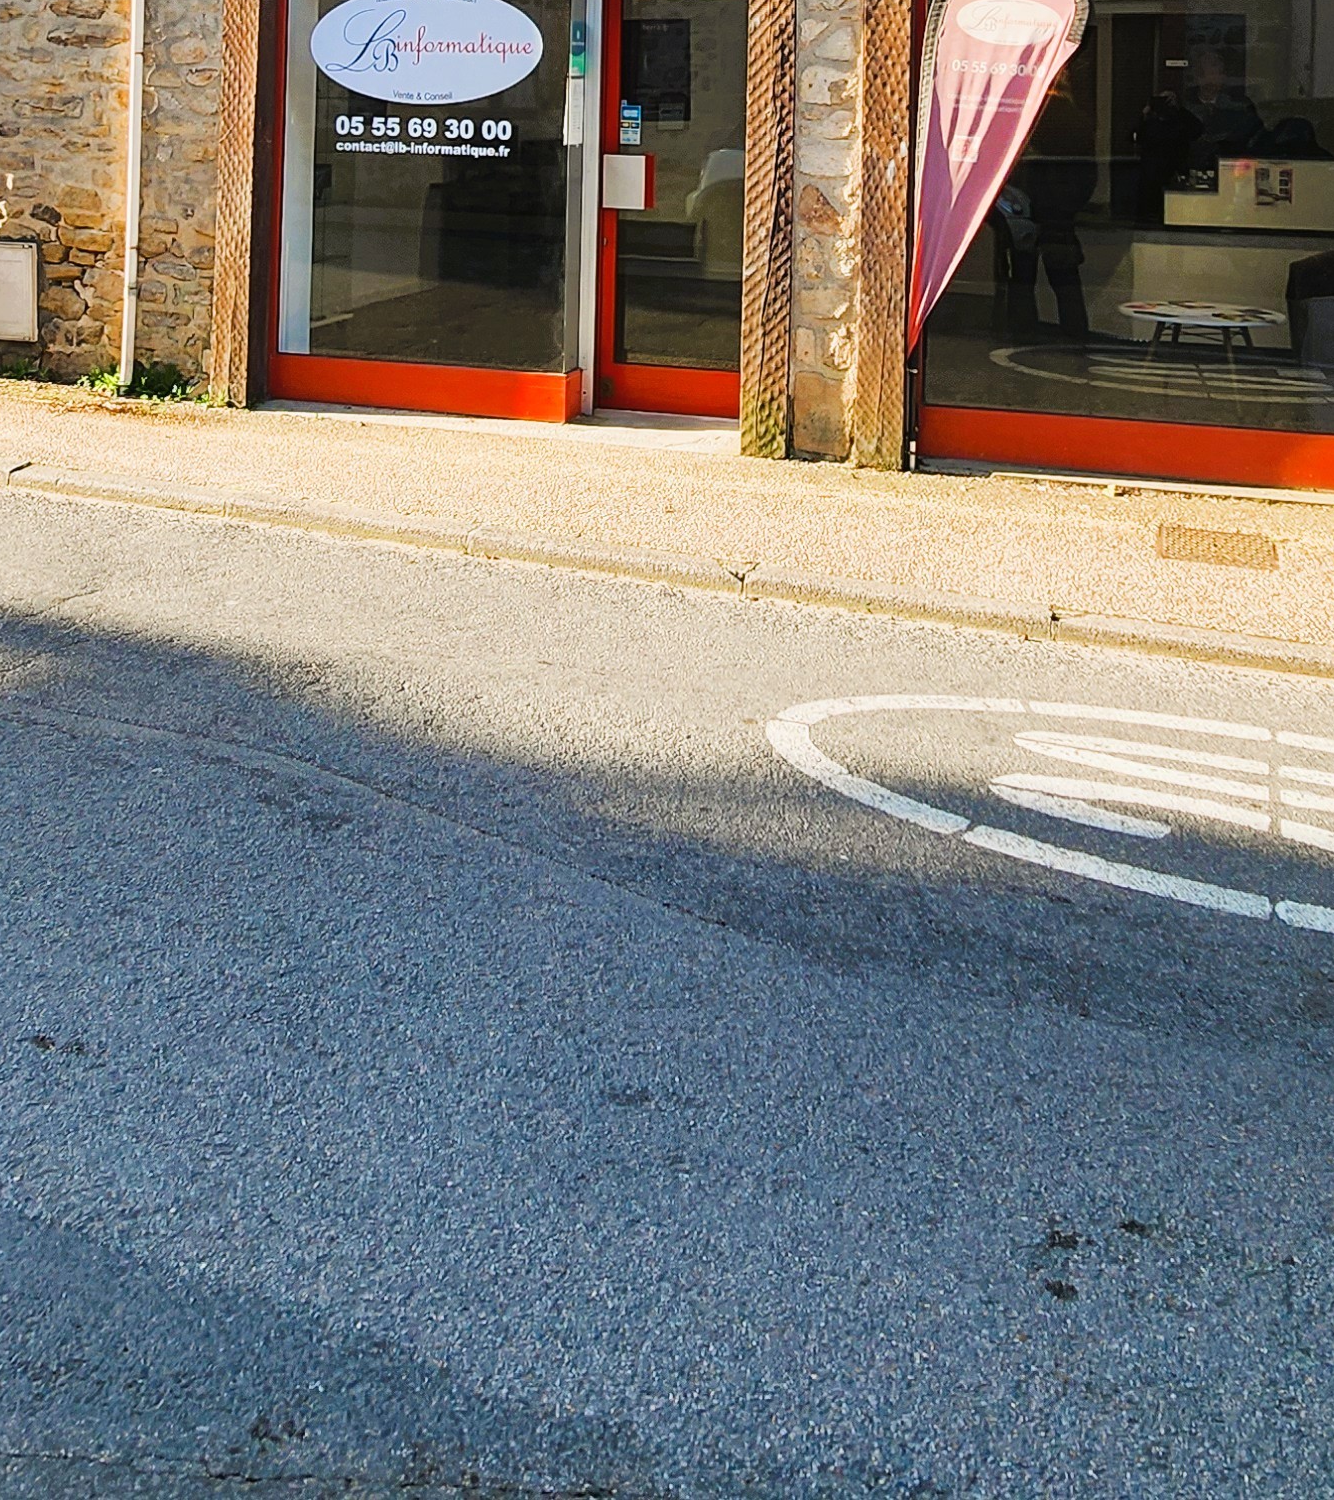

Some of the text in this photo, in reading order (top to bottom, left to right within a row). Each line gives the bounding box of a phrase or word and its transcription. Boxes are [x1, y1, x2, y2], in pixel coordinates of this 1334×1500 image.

[971, 60, 987, 73] 55
[990, 62, 1007, 75] 69
[1009, 63, 1027, 75] 30
[393, 89, 414, 100] Vente
[424, 91, 453, 101] Conseil
[335, 115, 512, 141] 05 55 69 30 00
